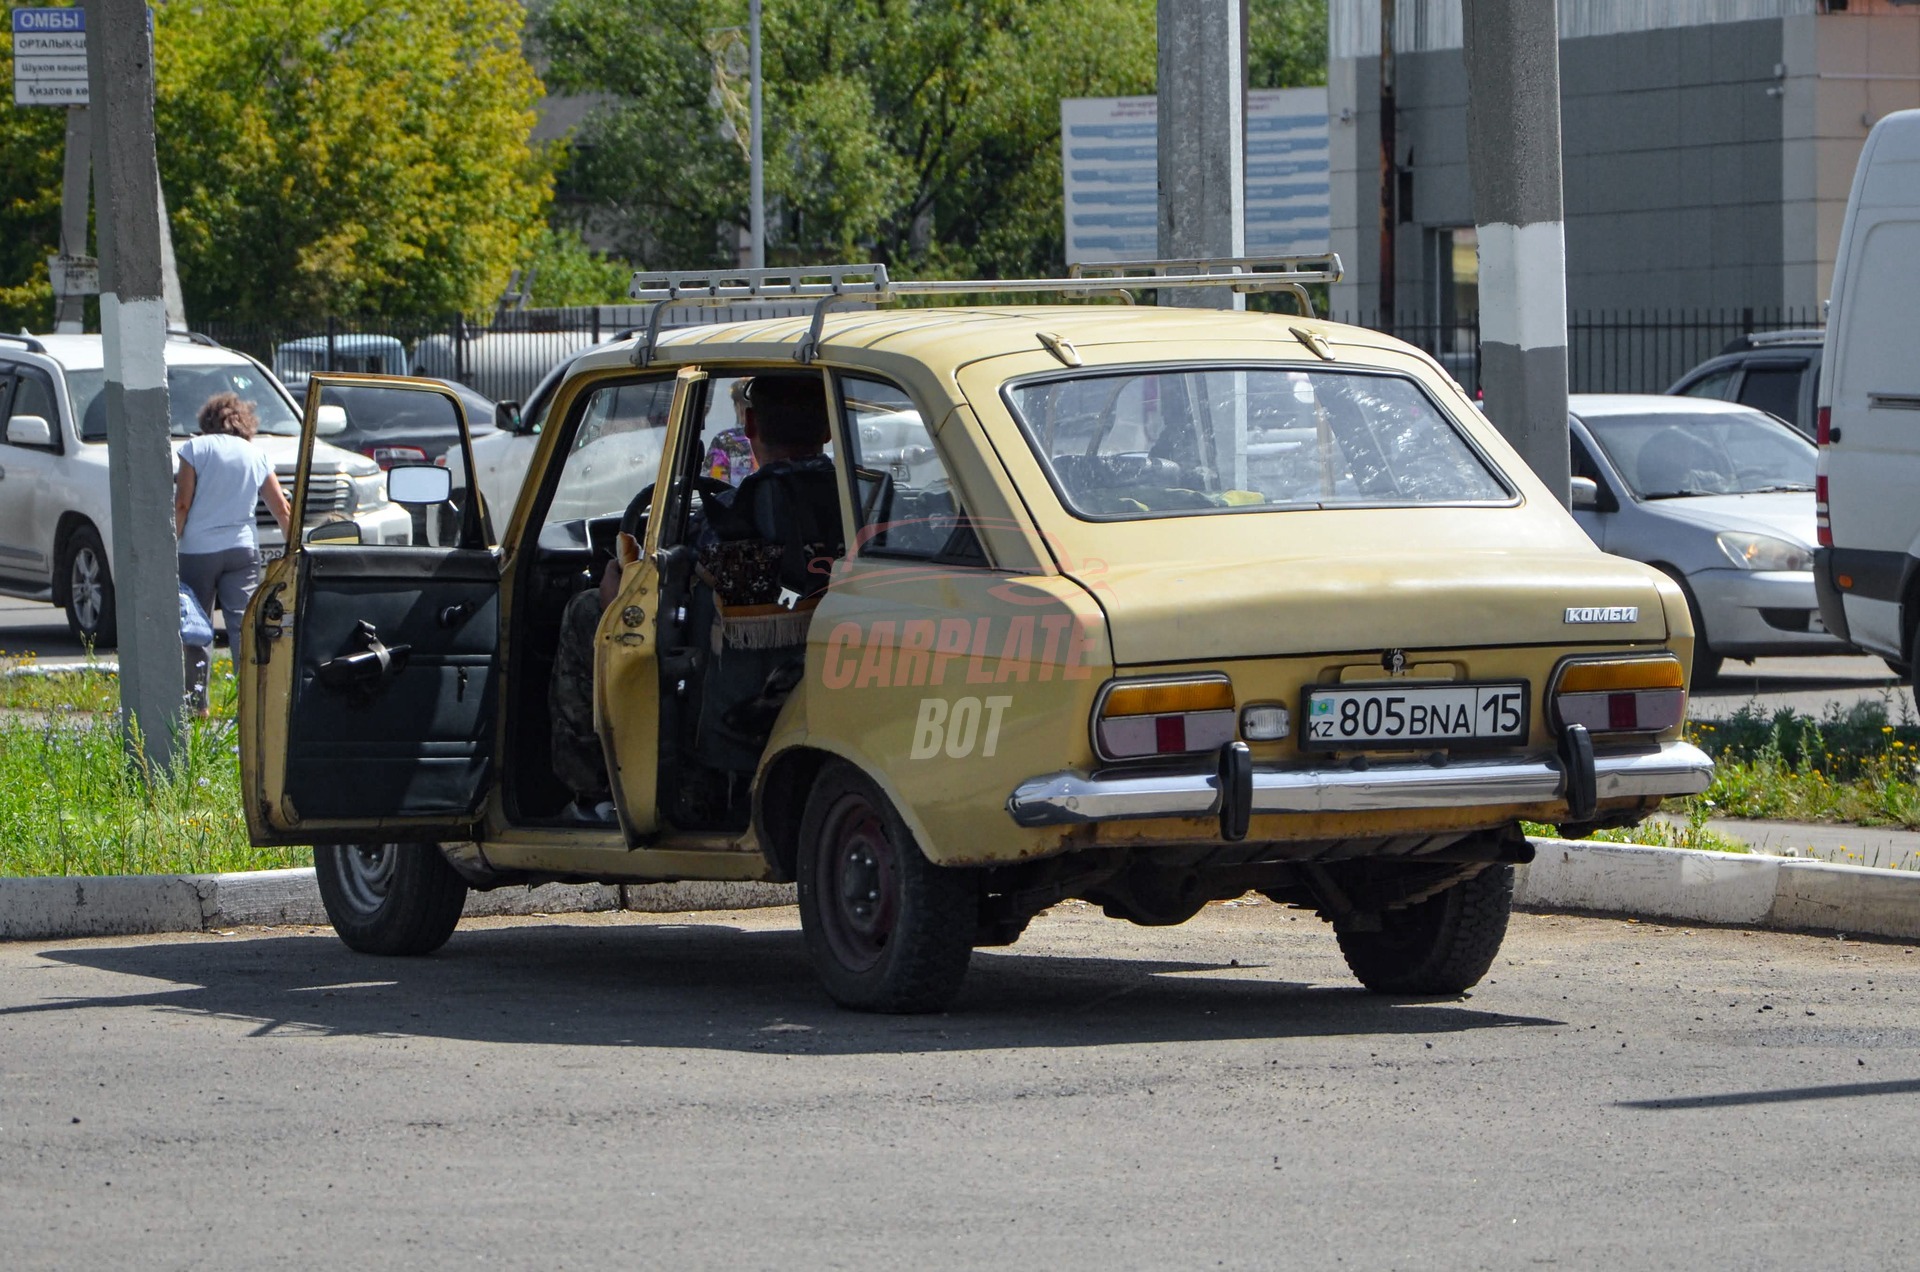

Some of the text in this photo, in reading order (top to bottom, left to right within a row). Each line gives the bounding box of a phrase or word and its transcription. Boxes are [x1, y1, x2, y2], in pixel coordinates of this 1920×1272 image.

[20, 12, 79, 29] ОМБЫ
[1568, 608, 1635, 621] КОМБИ
[1482, 693, 1521, 733] 15
[1310, 721, 1334, 737] KZ
